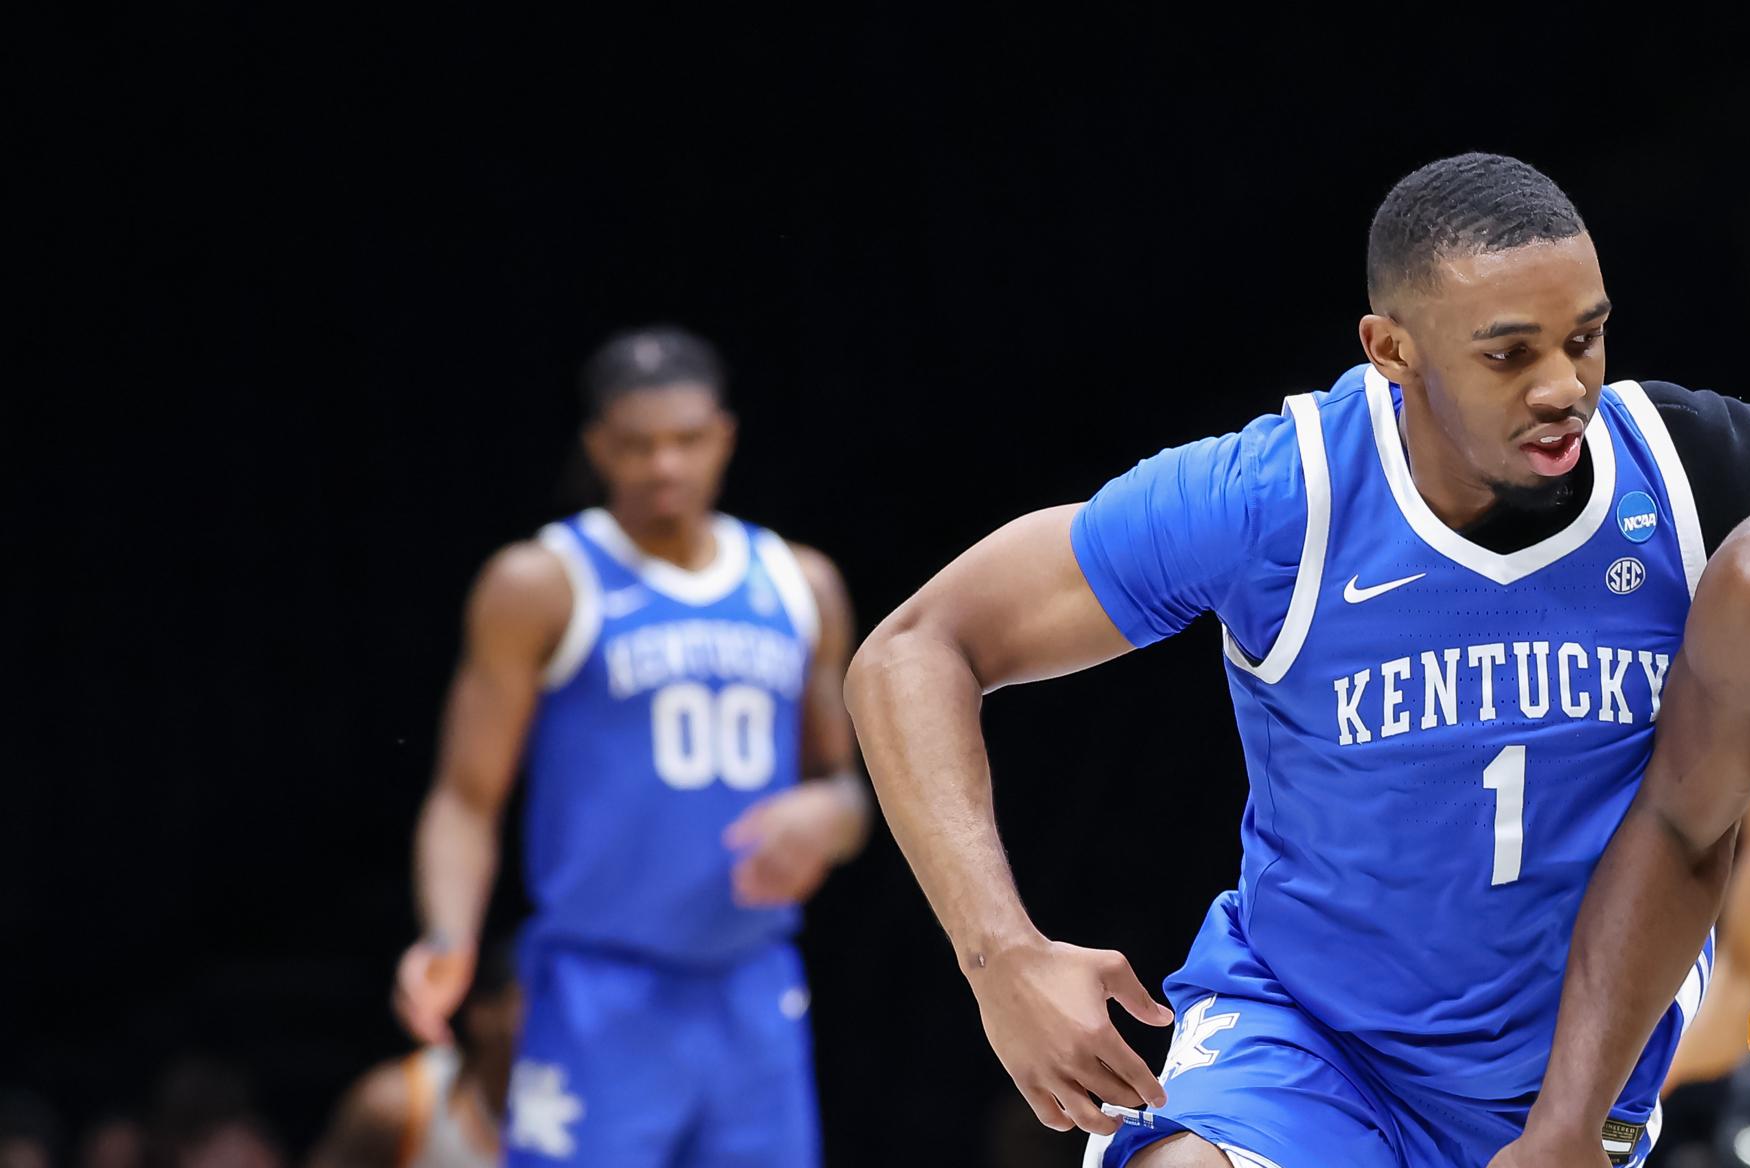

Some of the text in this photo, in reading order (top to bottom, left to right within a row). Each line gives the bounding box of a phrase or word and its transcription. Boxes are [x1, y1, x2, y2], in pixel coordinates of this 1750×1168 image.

[1623, 513, 1656, 532] NCAA
[1609, 560, 1642, 592] SEC
[654, 681, 776, 791] 00
[1333, 641, 1670, 746] KENTUCKY
[1482, 745, 1526, 886] 1
